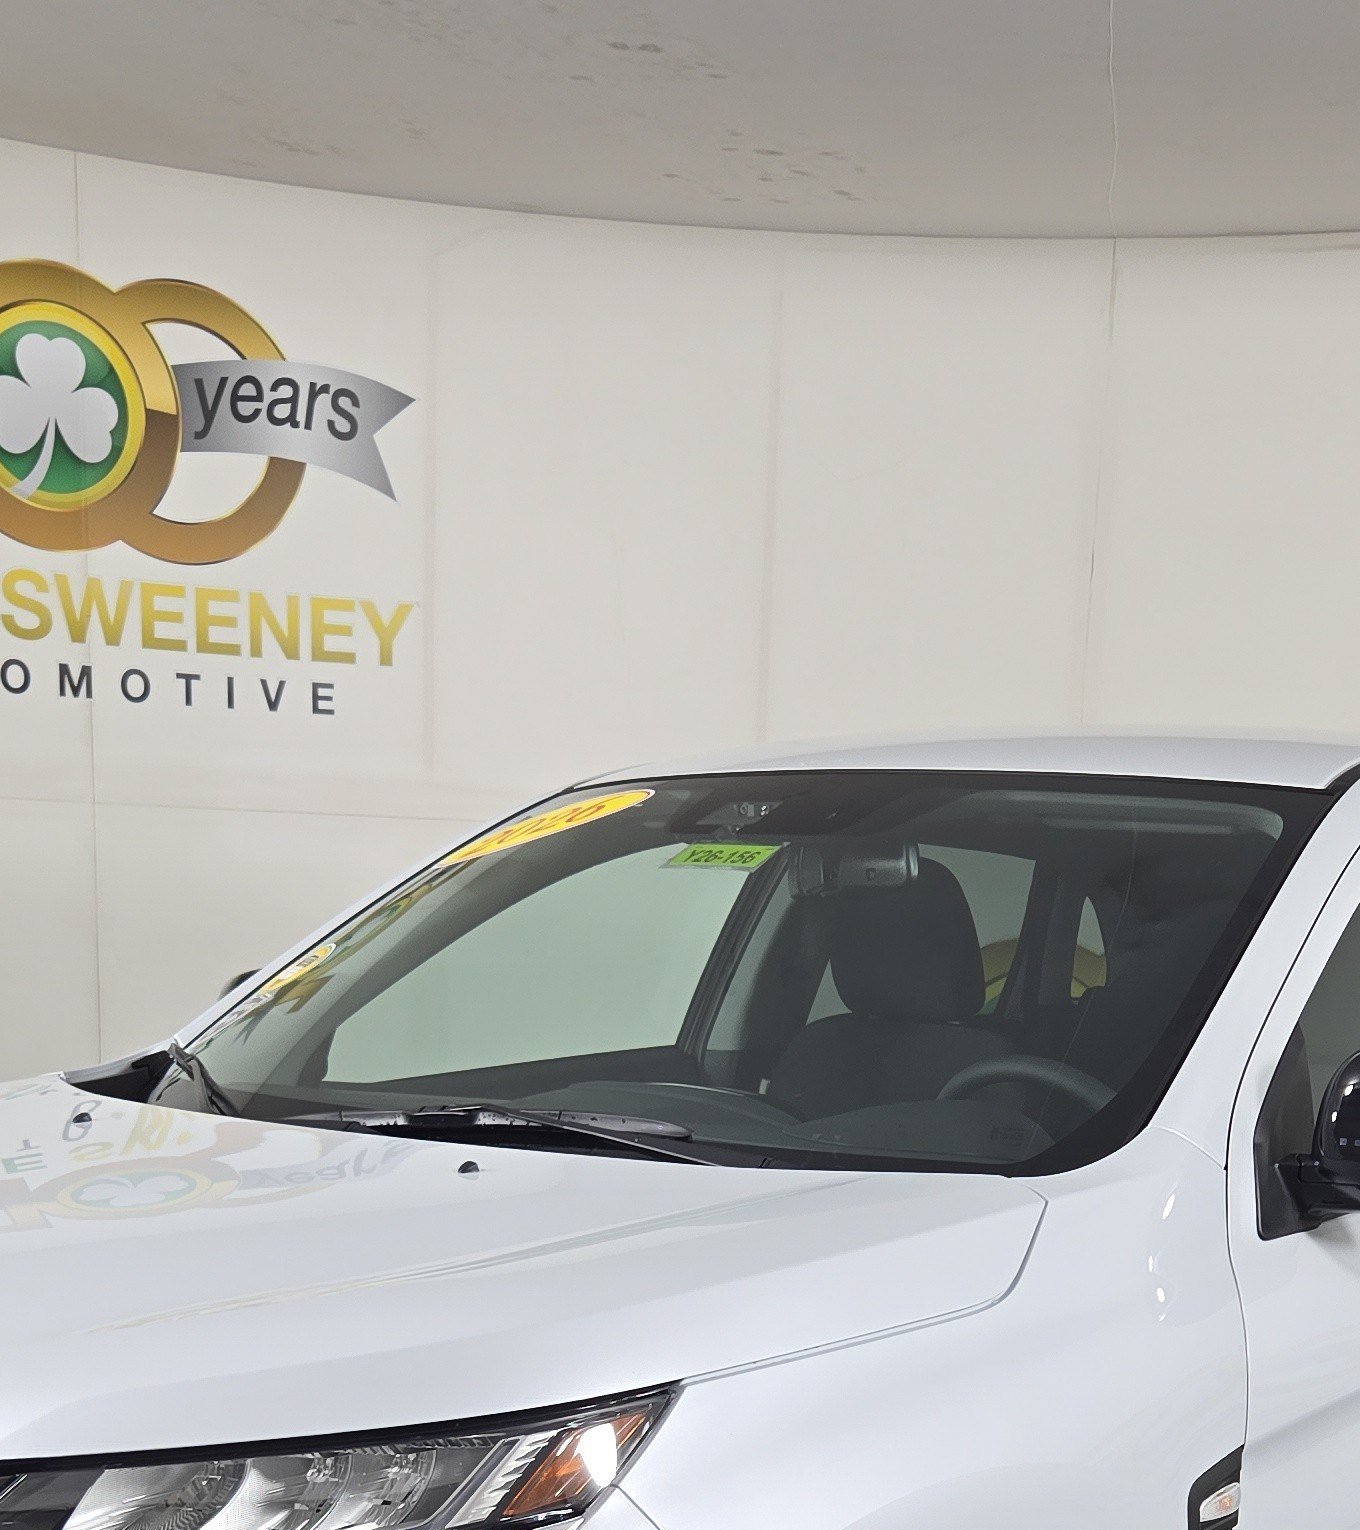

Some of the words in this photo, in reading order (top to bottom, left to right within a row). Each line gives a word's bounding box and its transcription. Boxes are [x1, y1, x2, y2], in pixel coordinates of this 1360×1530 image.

[193, 372, 361, 441] years
[0, 568, 414, 667] SWEENEY
[683, 849, 762, 865] Y26-156
